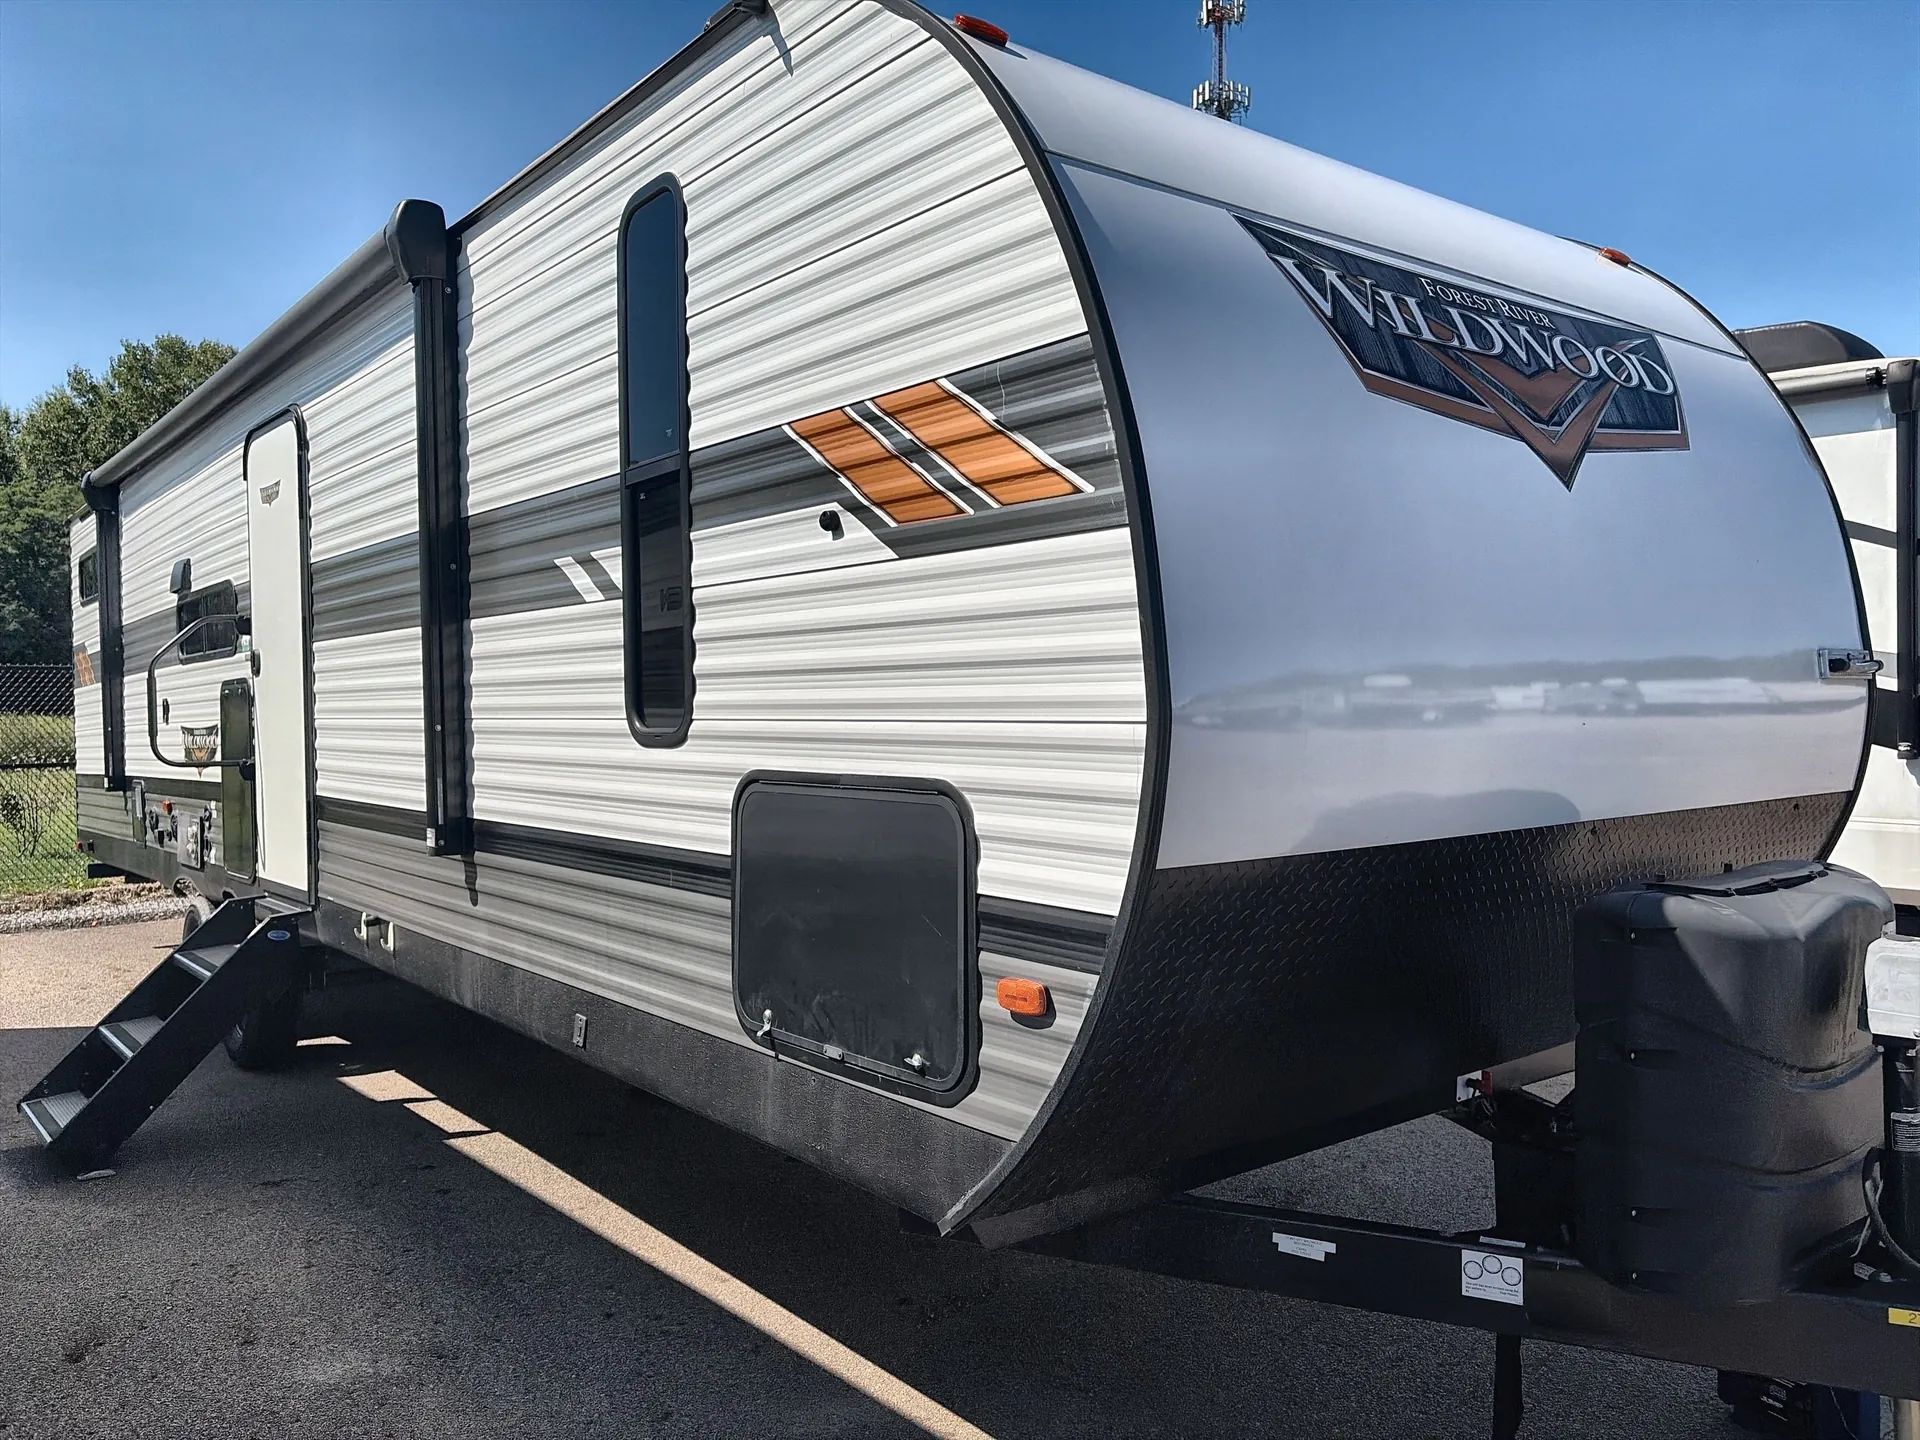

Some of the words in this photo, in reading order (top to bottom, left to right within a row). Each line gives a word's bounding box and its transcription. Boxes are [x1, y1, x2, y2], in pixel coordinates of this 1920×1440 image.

[1268, 252, 1676, 395] WILDWOOD
[1418, 276, 1497, 314] FOREST
[1495, 298, 1556, 329] RIVER
